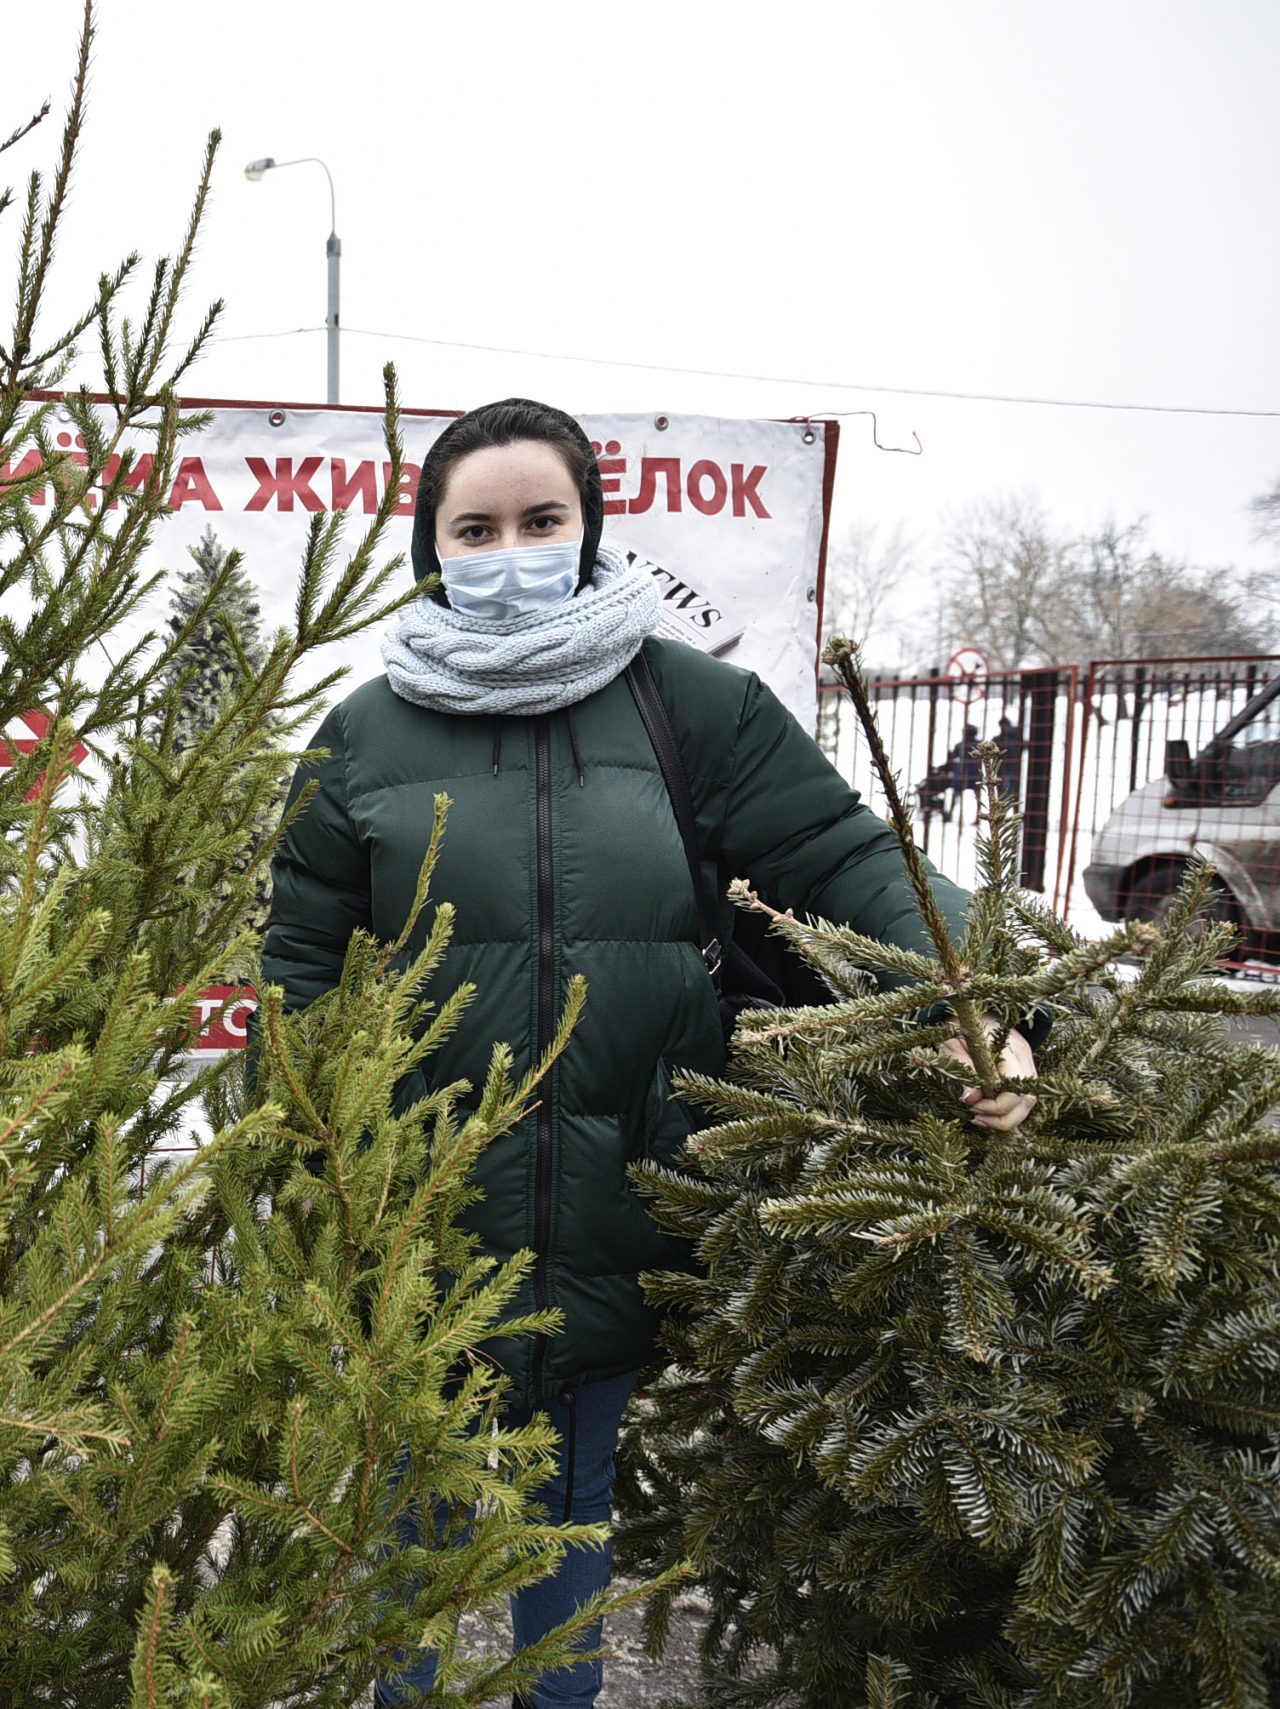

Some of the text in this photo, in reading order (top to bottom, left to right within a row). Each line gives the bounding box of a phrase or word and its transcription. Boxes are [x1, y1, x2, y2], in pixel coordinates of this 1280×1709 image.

[244, 457, 422, 516] ЖИВ
[591, 440, 772, 519] ЁЛОК
[625, 550, 724, 628] EWS
